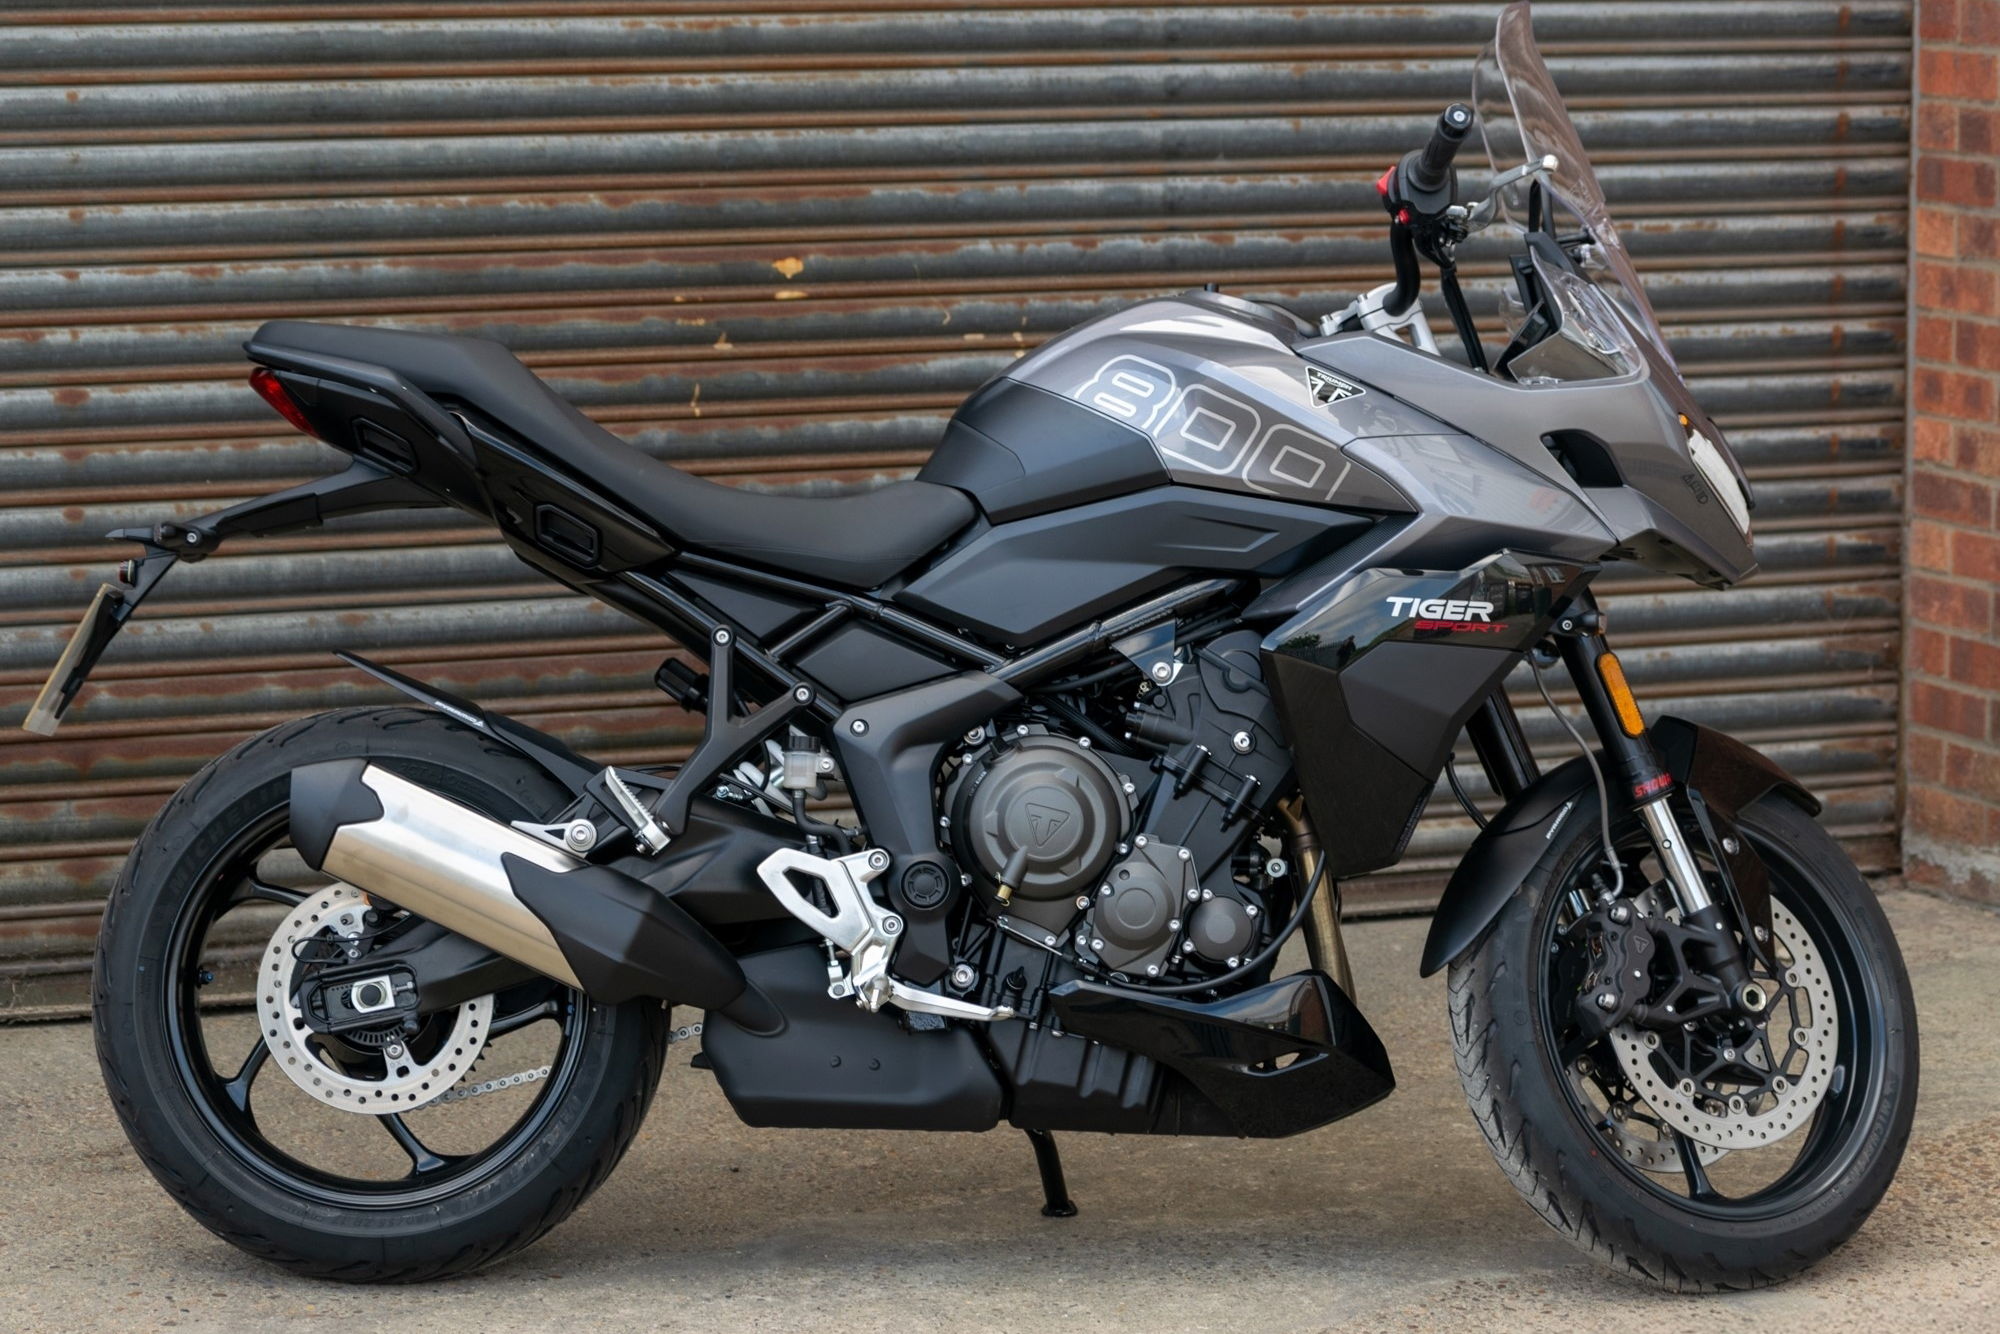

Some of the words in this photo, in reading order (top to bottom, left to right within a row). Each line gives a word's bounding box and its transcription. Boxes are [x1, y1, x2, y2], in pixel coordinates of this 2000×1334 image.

[1317, 371, 1353, 391] TRIUMPH
[1073, 354, 1351, 501] 800
[1386, 596, 1494, 622] TIGER
[1413, 620, 1509, 633] SPORT
